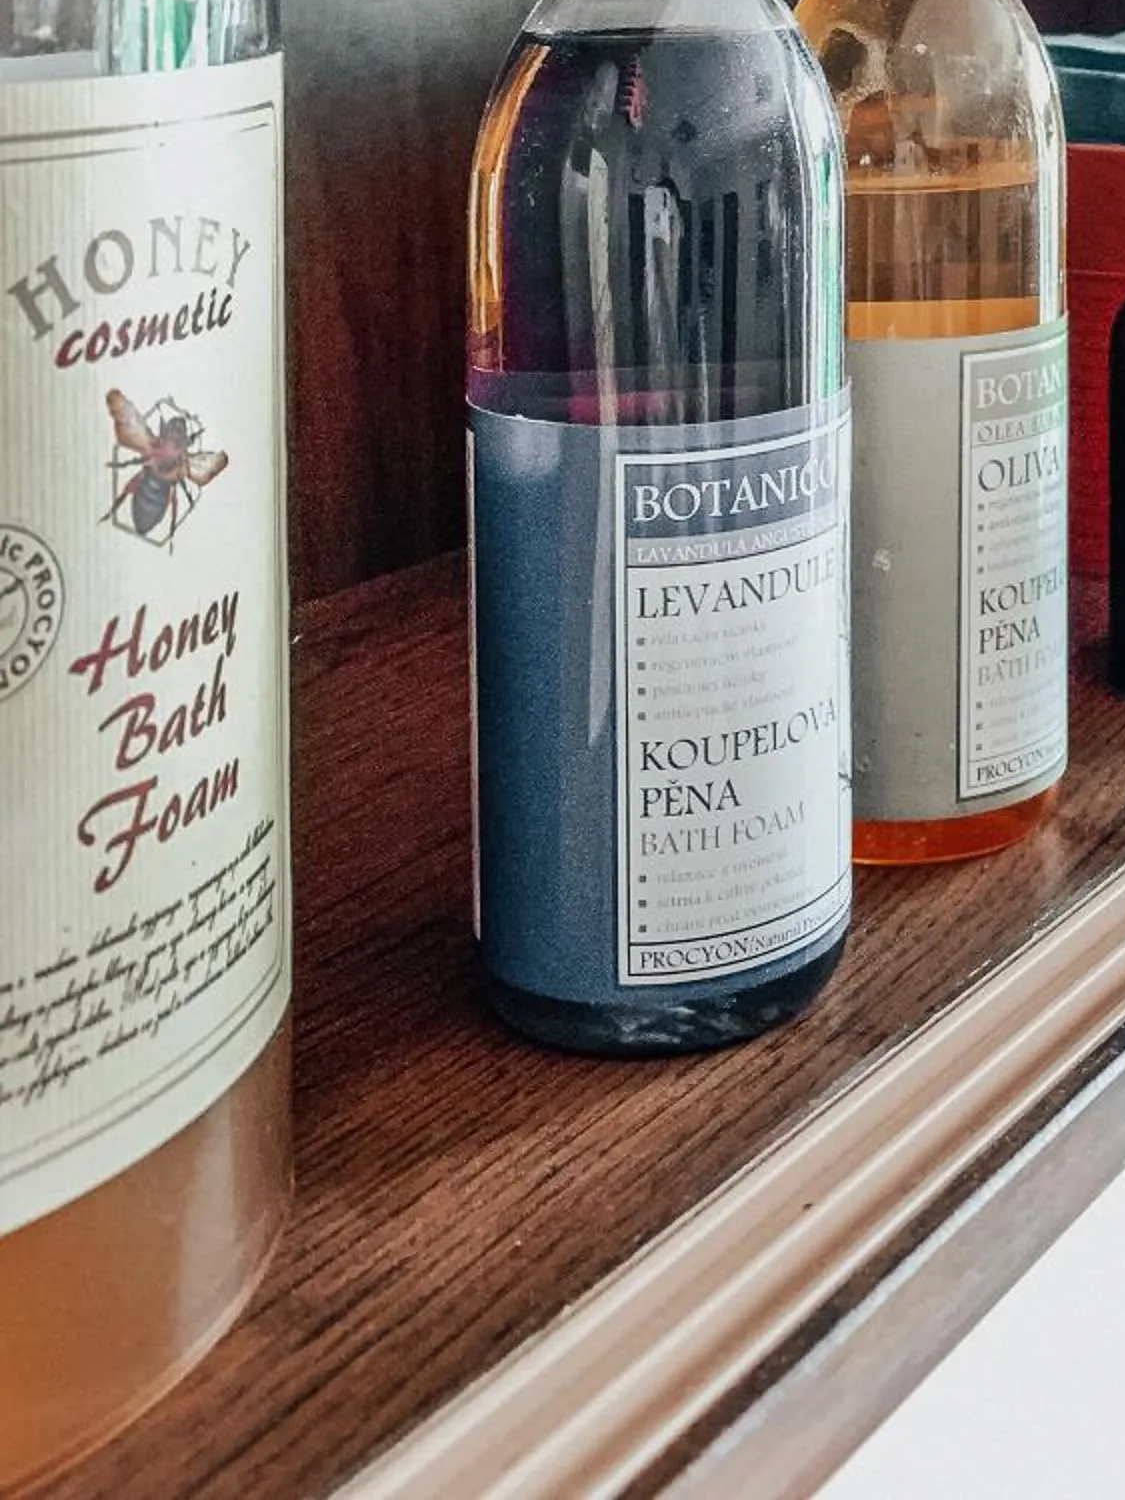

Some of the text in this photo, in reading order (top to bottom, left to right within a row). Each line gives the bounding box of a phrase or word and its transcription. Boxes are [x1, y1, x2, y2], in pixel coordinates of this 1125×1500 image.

[7, 215, 251, 341] HONEY
[55, 287, 233, 369] cosmetic
[977, 445, 1060, 493] OLIVA
[69, 592, 239, 696] Honey
[979, 615, 1041, 655] PĚNA
[98, 654, 226, 770] Bath
[77, 758, 239, 894] Foam
[639, 778, 741, 819] PĚNA
[641, 800, 806, 857] BATH FOAM
